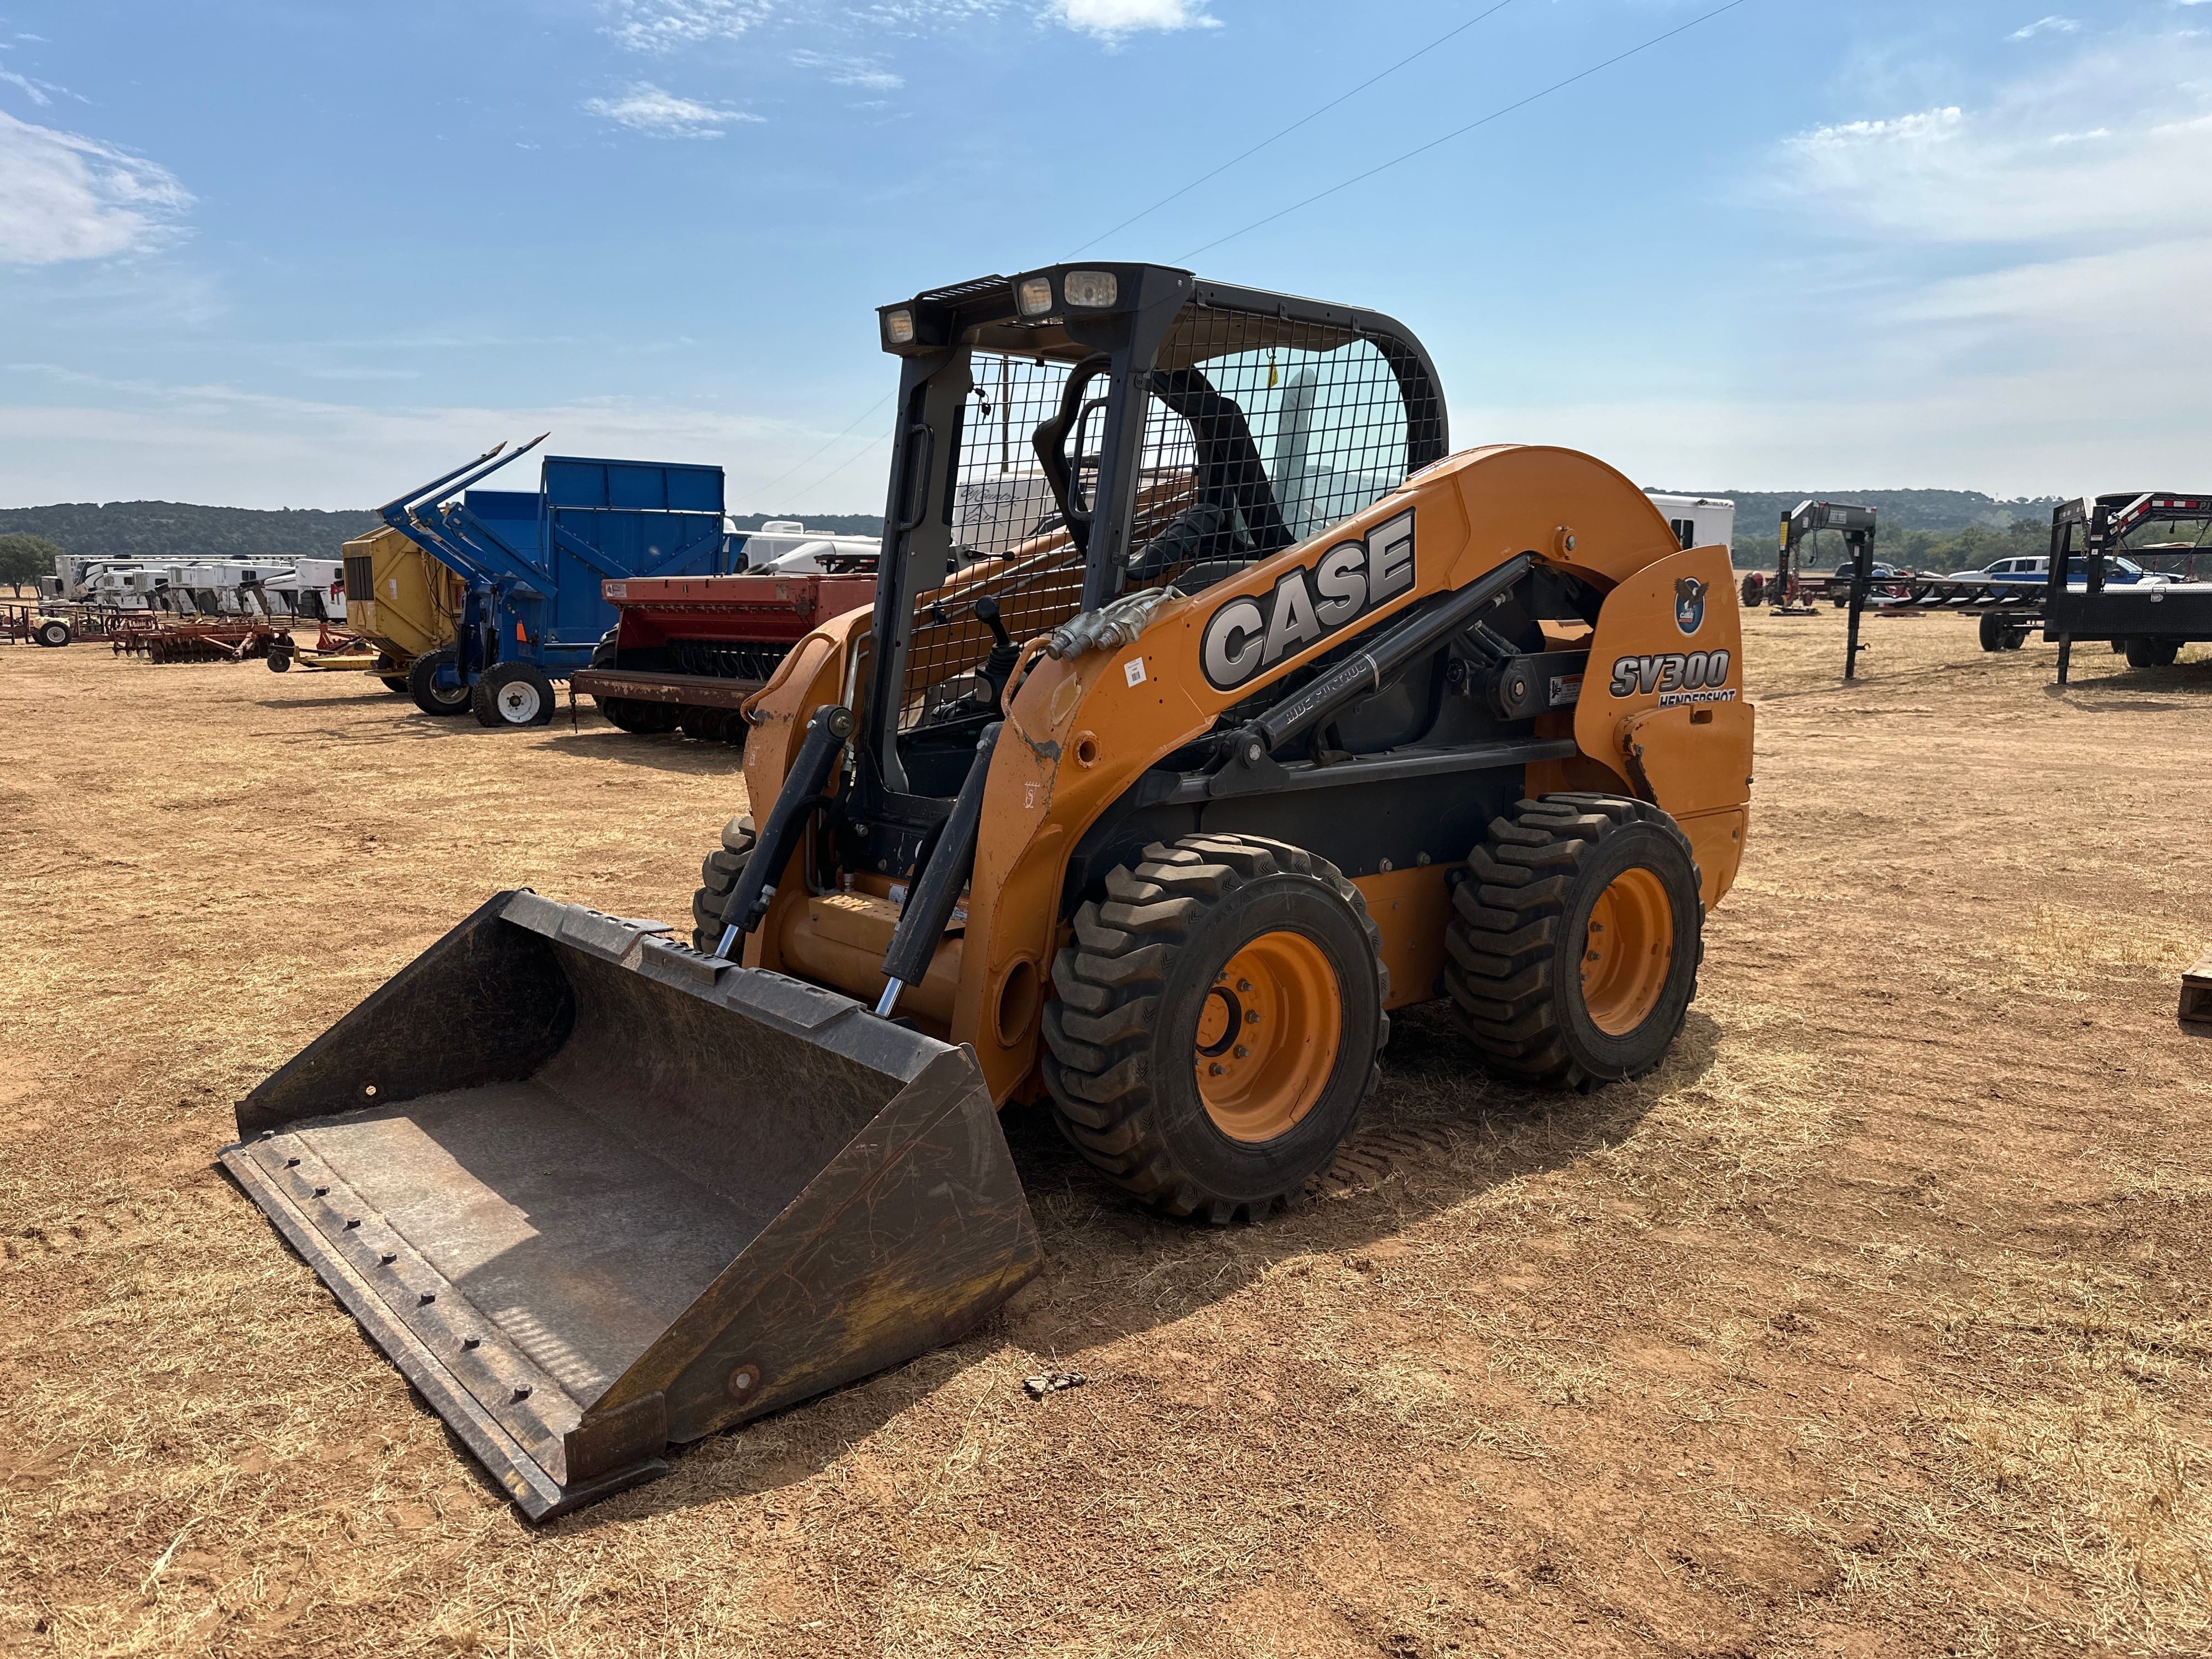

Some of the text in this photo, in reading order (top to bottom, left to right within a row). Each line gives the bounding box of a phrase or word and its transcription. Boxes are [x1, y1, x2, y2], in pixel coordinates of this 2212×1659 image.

[1203, 513, 1413, 687] CASE
[1610, 649, 1730, 697] SV300
[1660, 690, 1736, 708] HENDERSHOT
